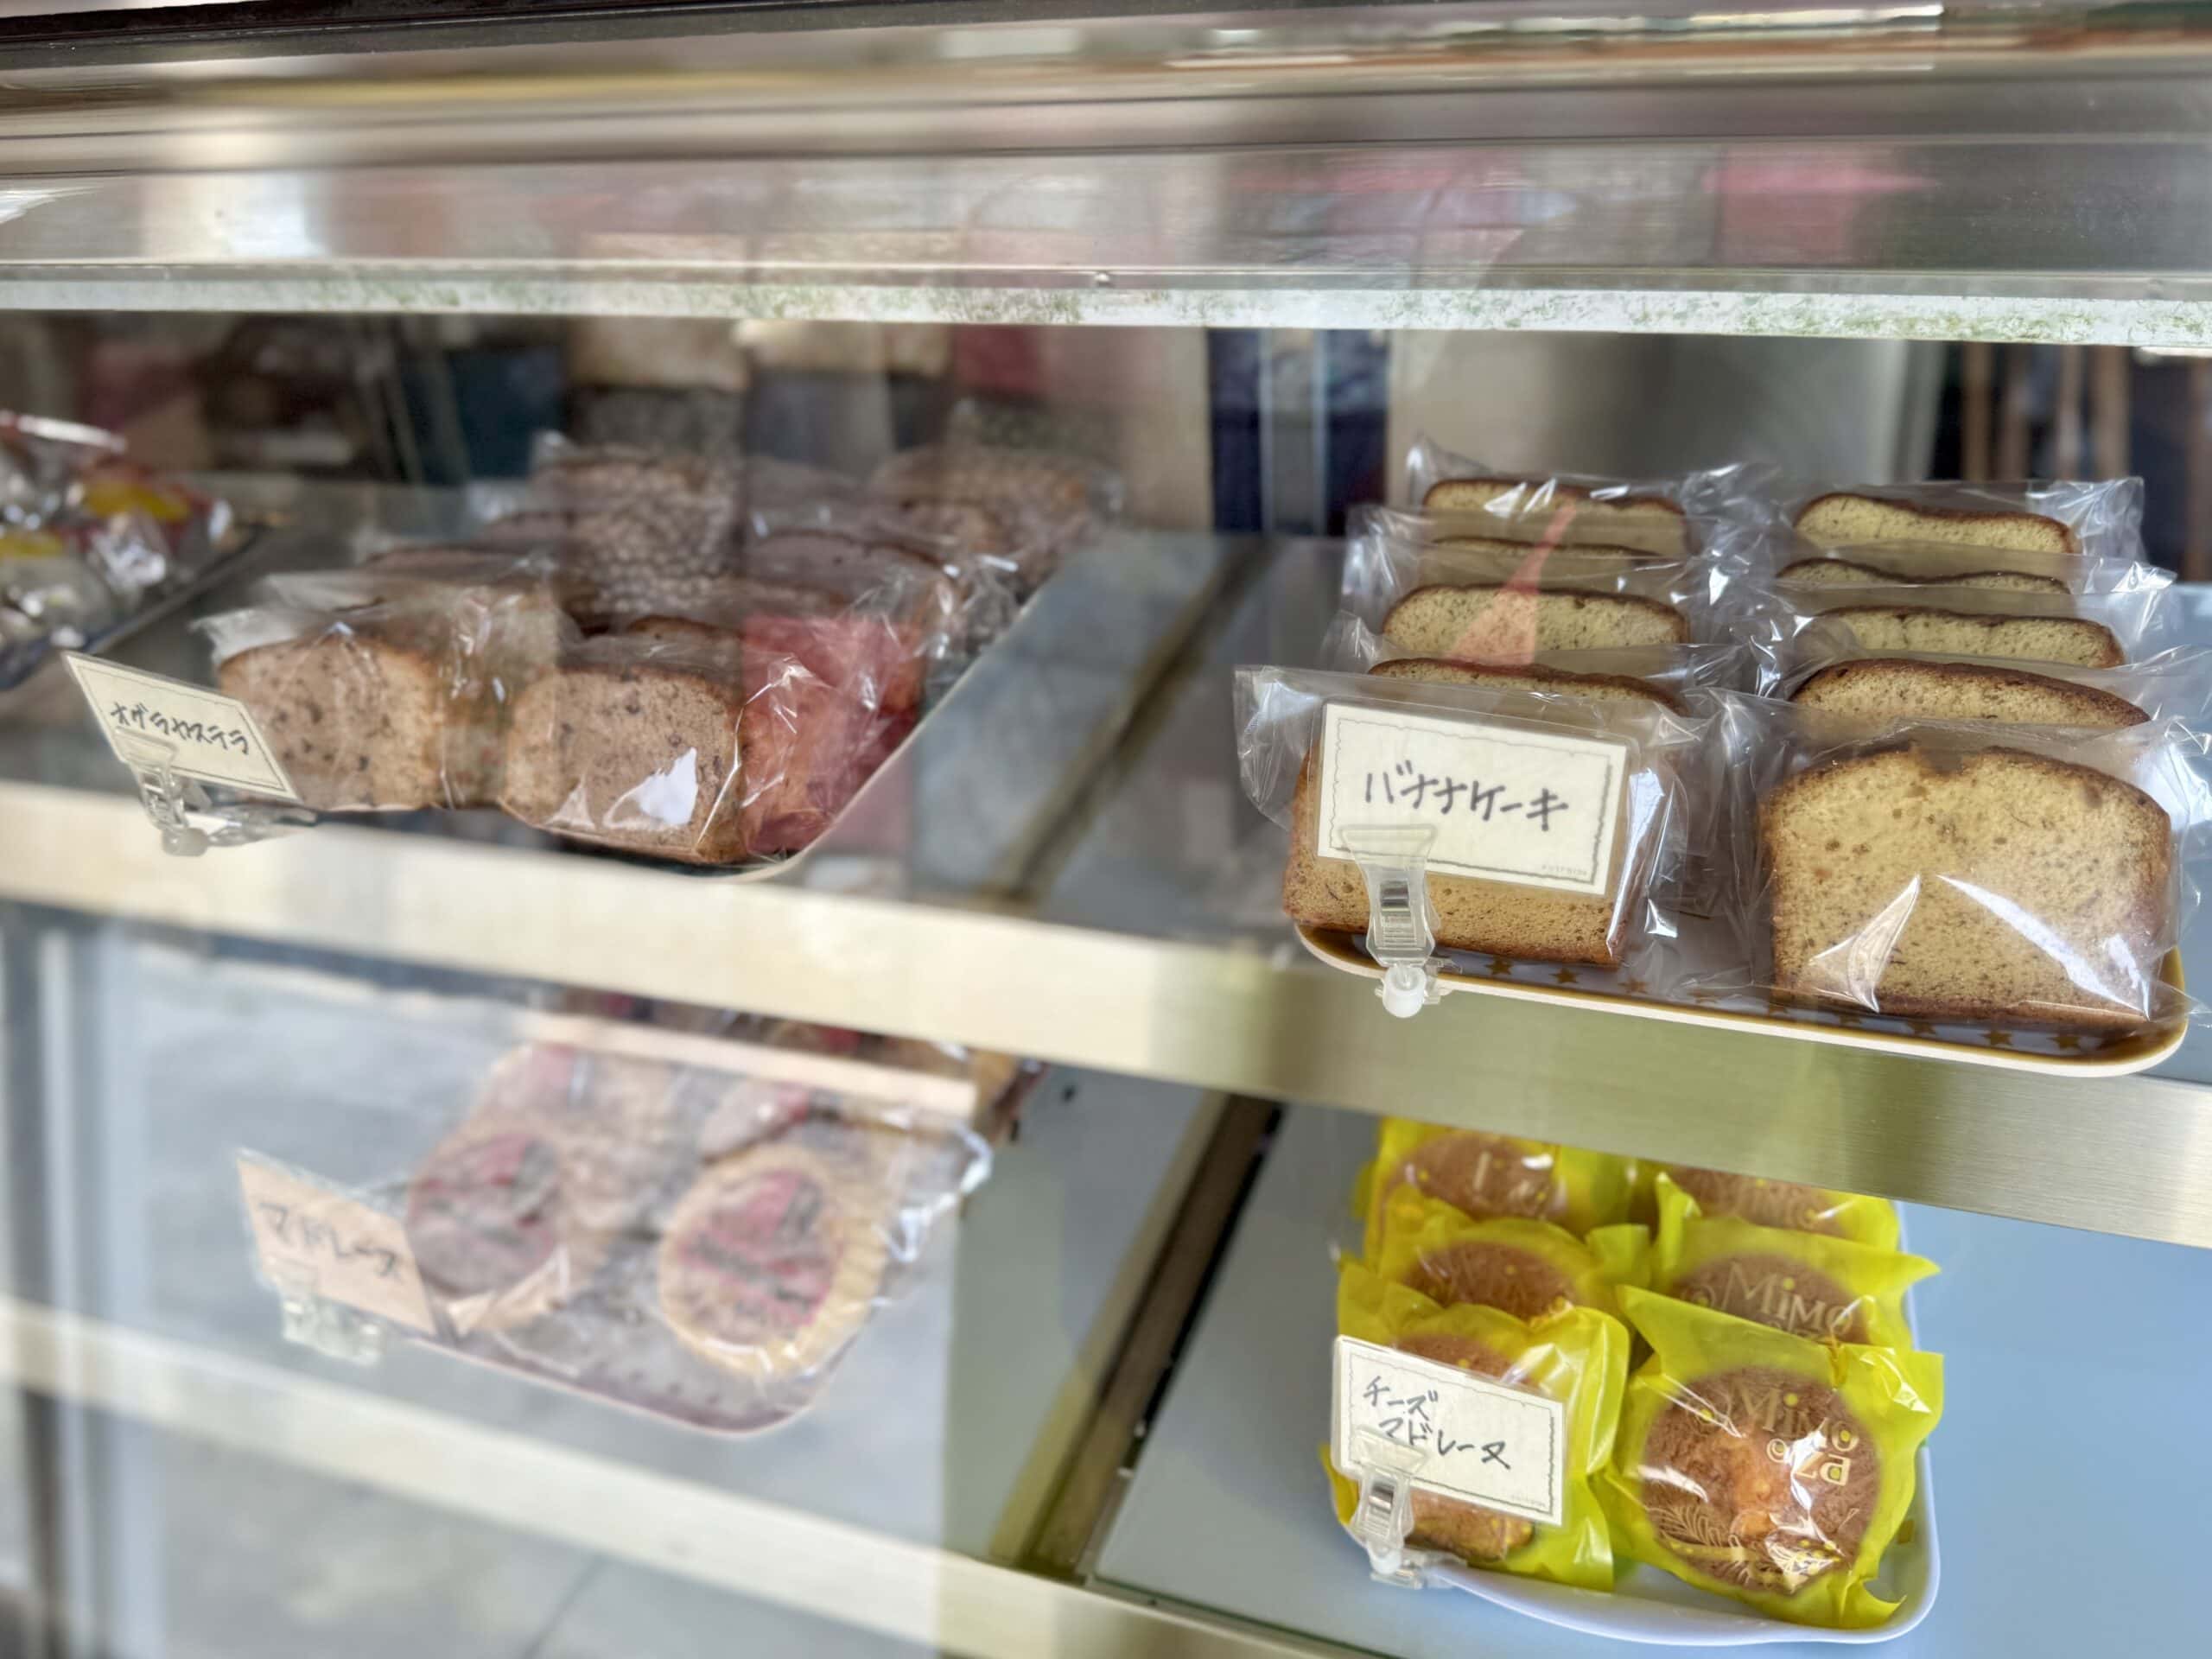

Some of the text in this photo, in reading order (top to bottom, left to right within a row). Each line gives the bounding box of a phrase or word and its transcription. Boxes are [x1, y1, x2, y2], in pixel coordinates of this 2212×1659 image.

[1365, 760, 1568, 831] バナナケーキ
[1362, 1376, 1439, 1421] チーズ
[1378, 1417, 1511, 1470] マドレーヌ
